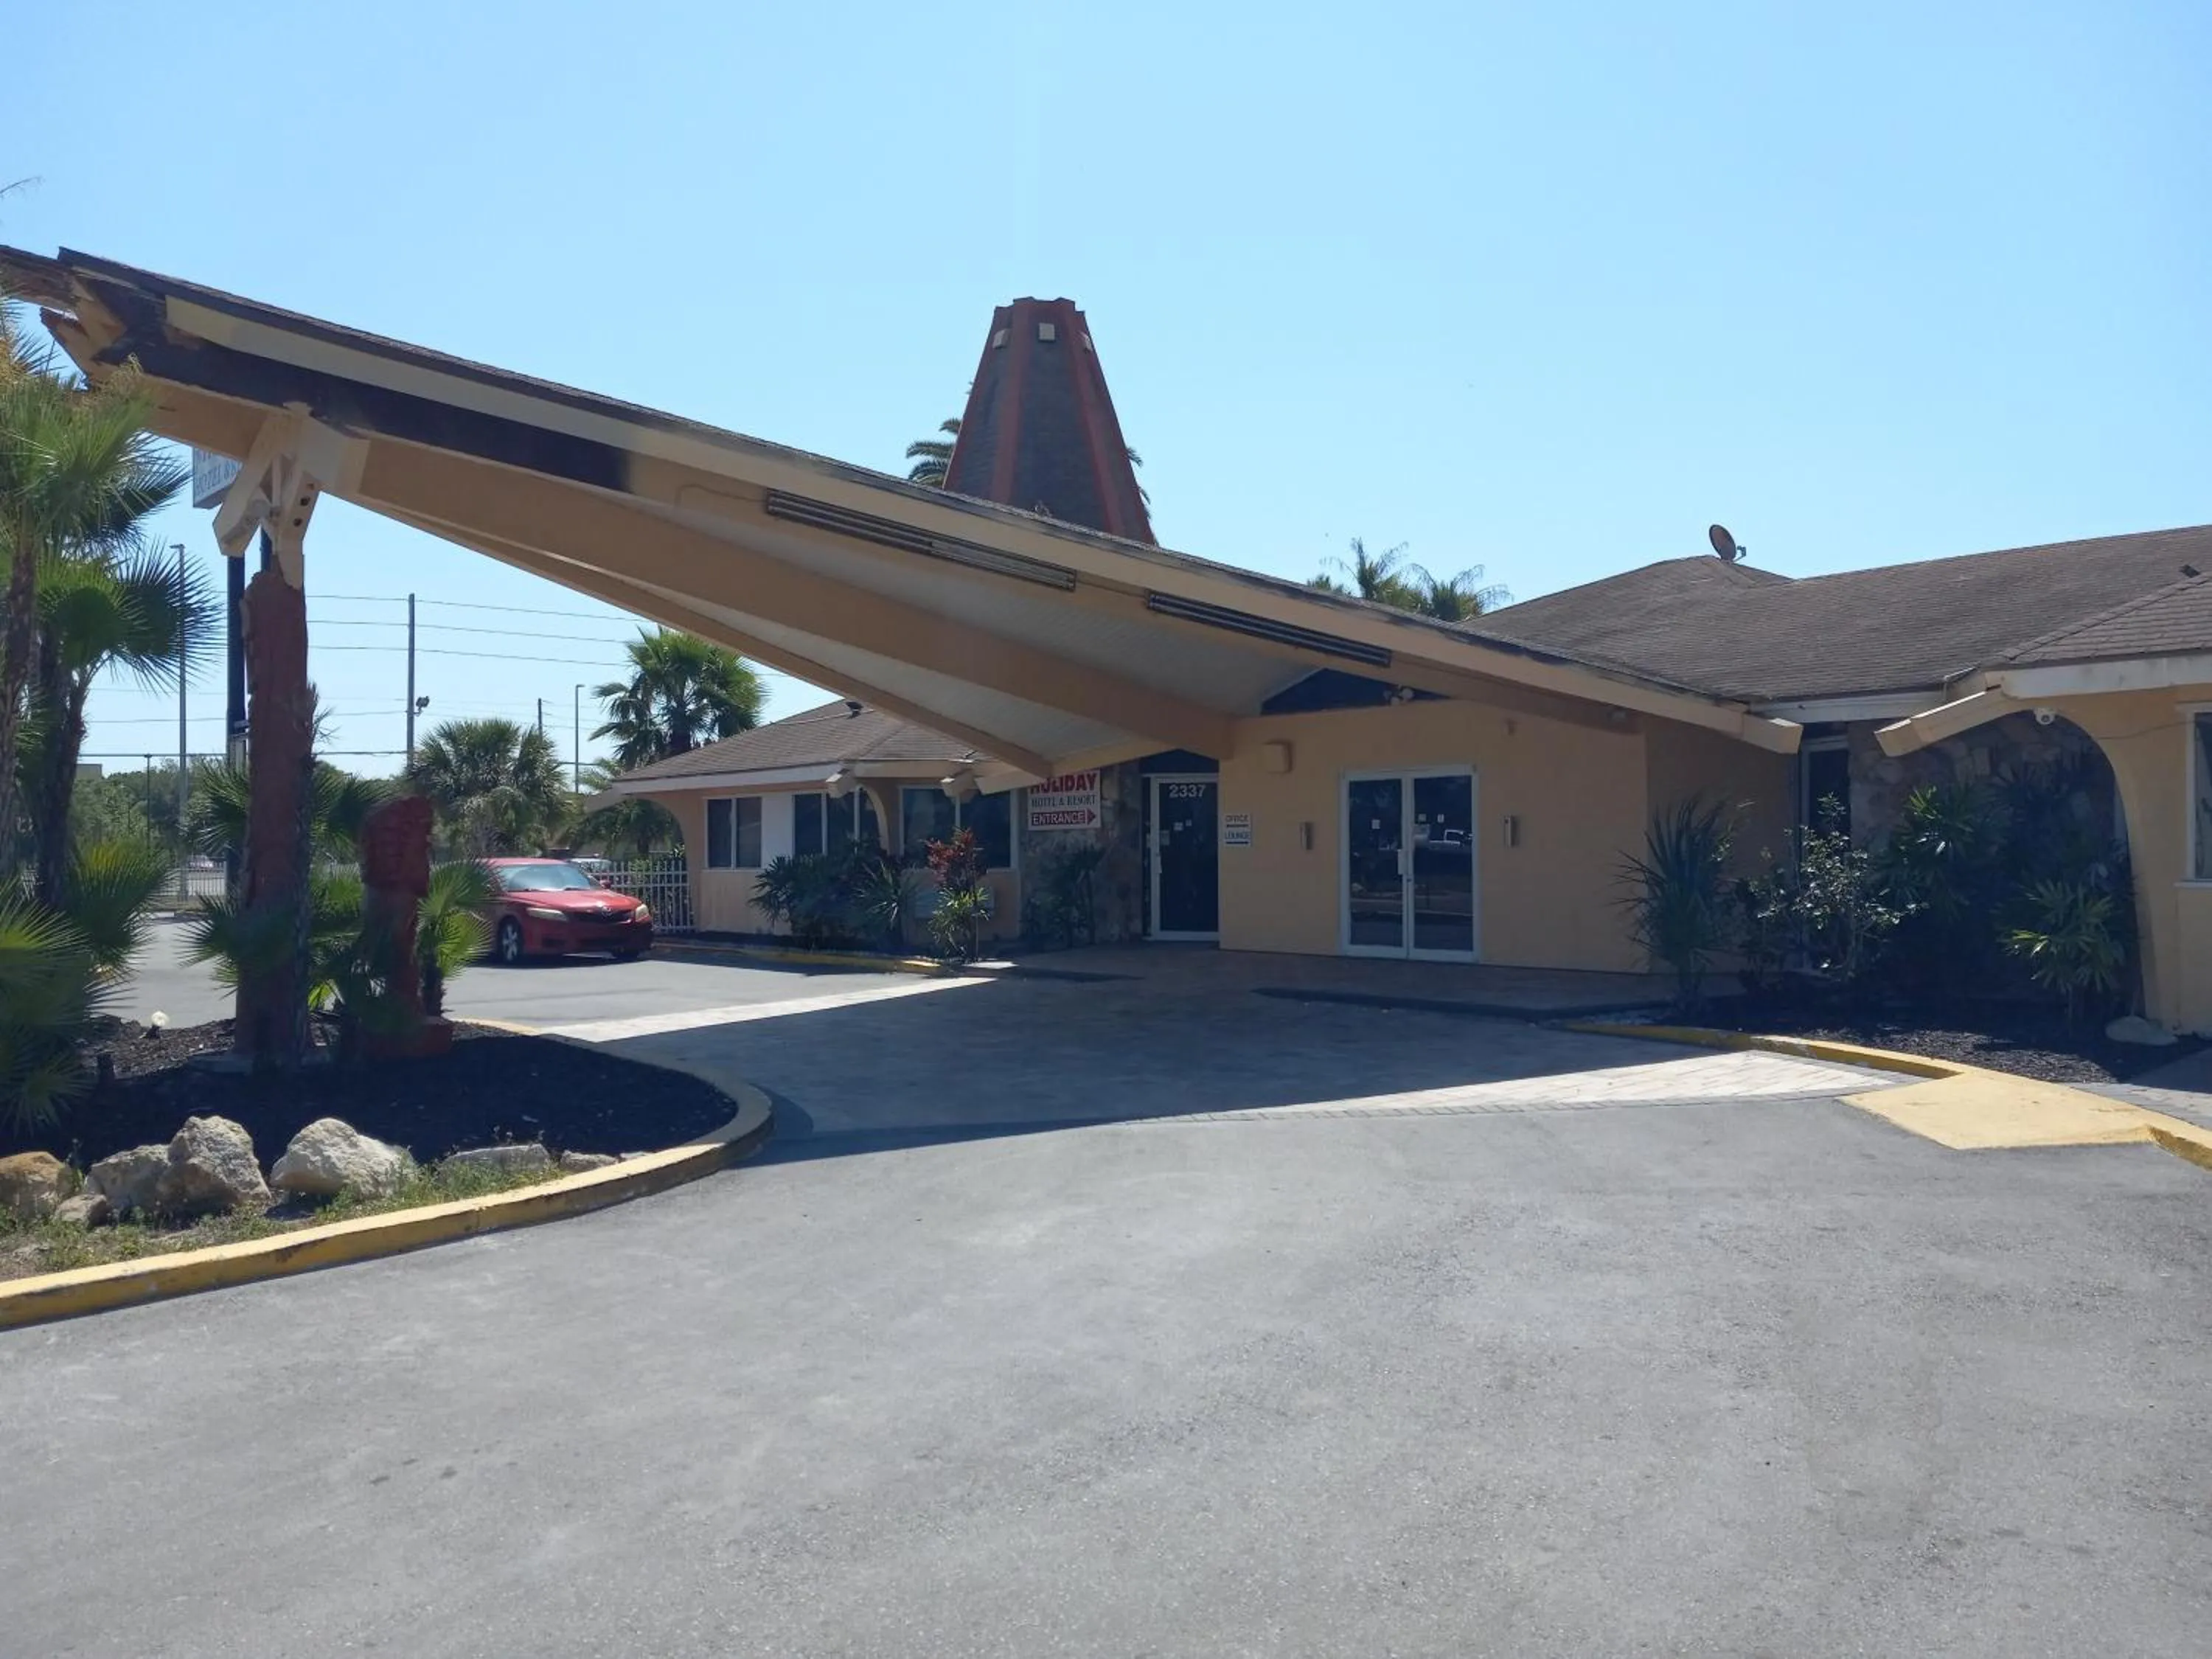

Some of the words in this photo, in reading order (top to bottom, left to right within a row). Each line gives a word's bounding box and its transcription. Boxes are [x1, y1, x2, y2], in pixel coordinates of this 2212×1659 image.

[1169, 784, 1206, 799] 2337
[1032, 796, 1055, 808] HOTEL
[1067, 795, 1096, 806] RESORT
[1033, 812, 1085, 825] ENTRANCE
[1225, 814, 1249, 822] OFFICE
[1225, 831, 1251, 840] LOUNGE
